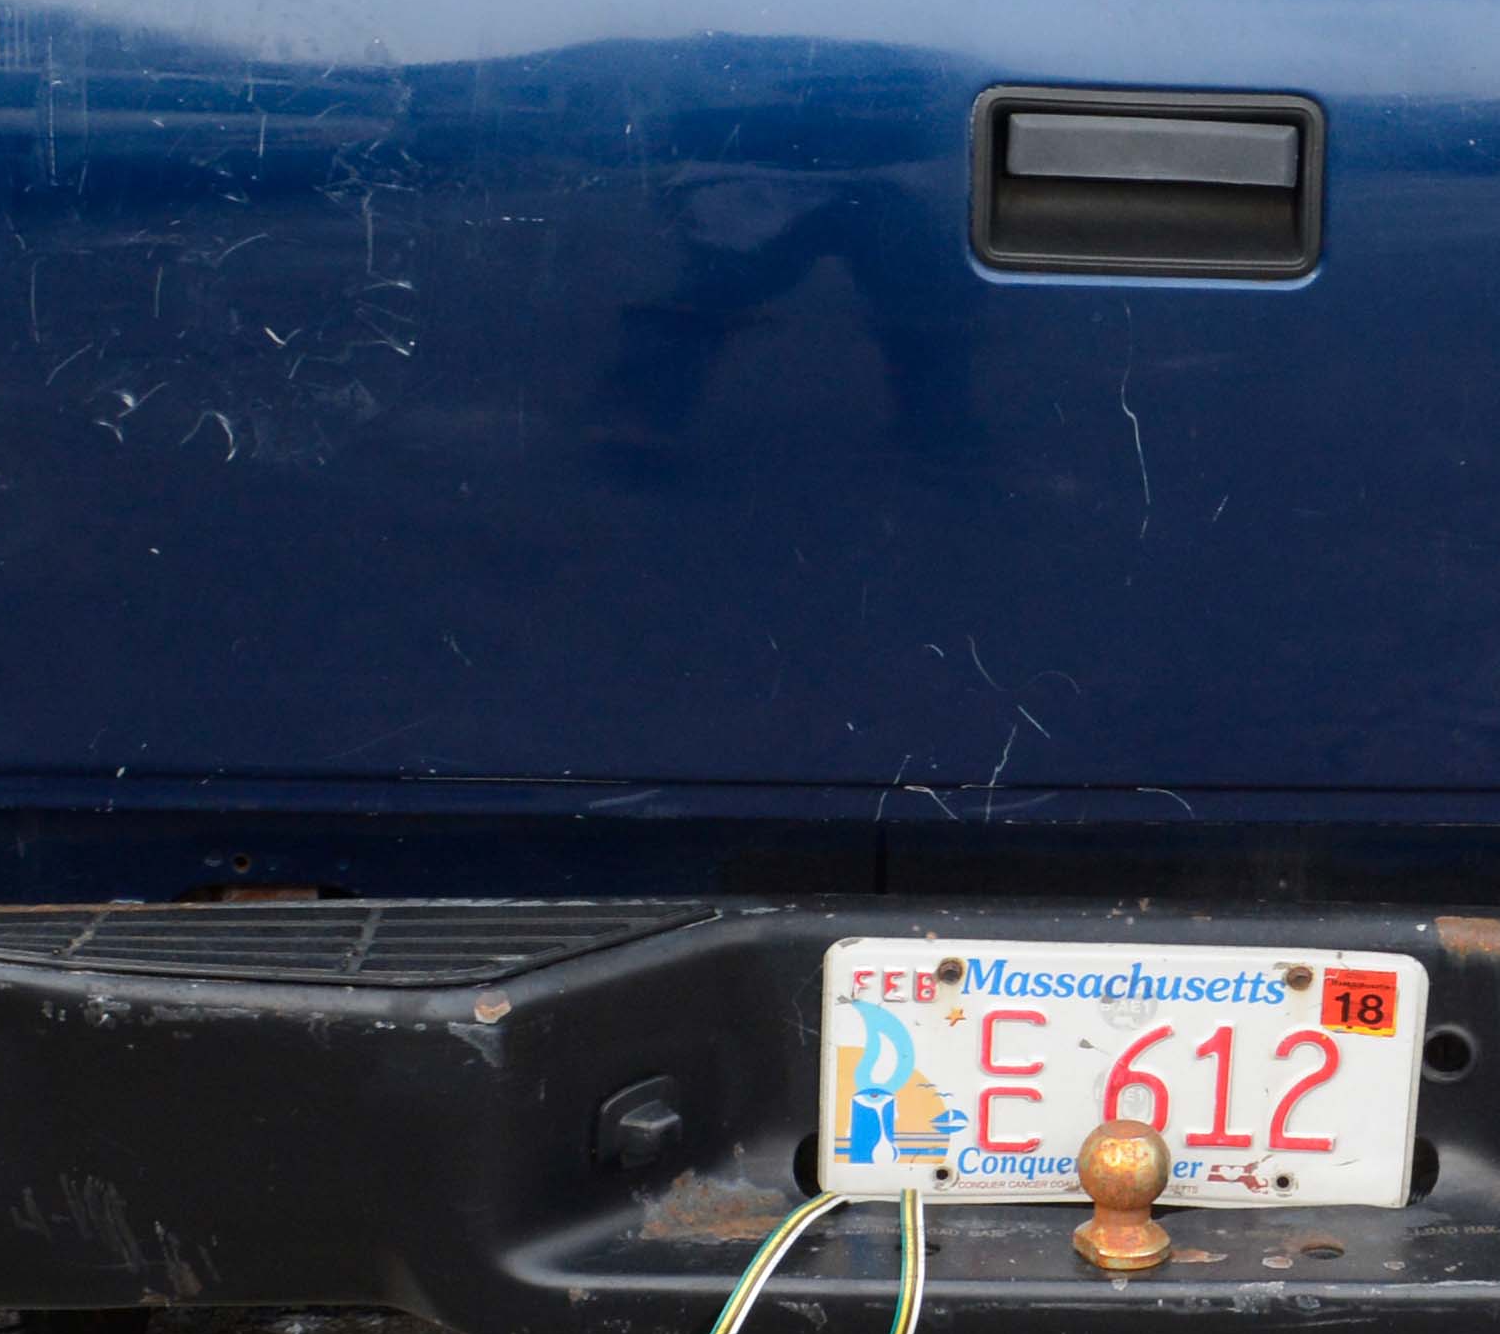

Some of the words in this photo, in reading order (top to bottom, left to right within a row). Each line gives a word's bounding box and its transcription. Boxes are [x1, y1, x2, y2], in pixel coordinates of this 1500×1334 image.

[852, 968, 938, 1003] FEB
[961, 958, 1287, 1005] Massachusetts
[1334, 990, 1385, 1026] 18
[1103, 1024, 1341, 1153] 612
